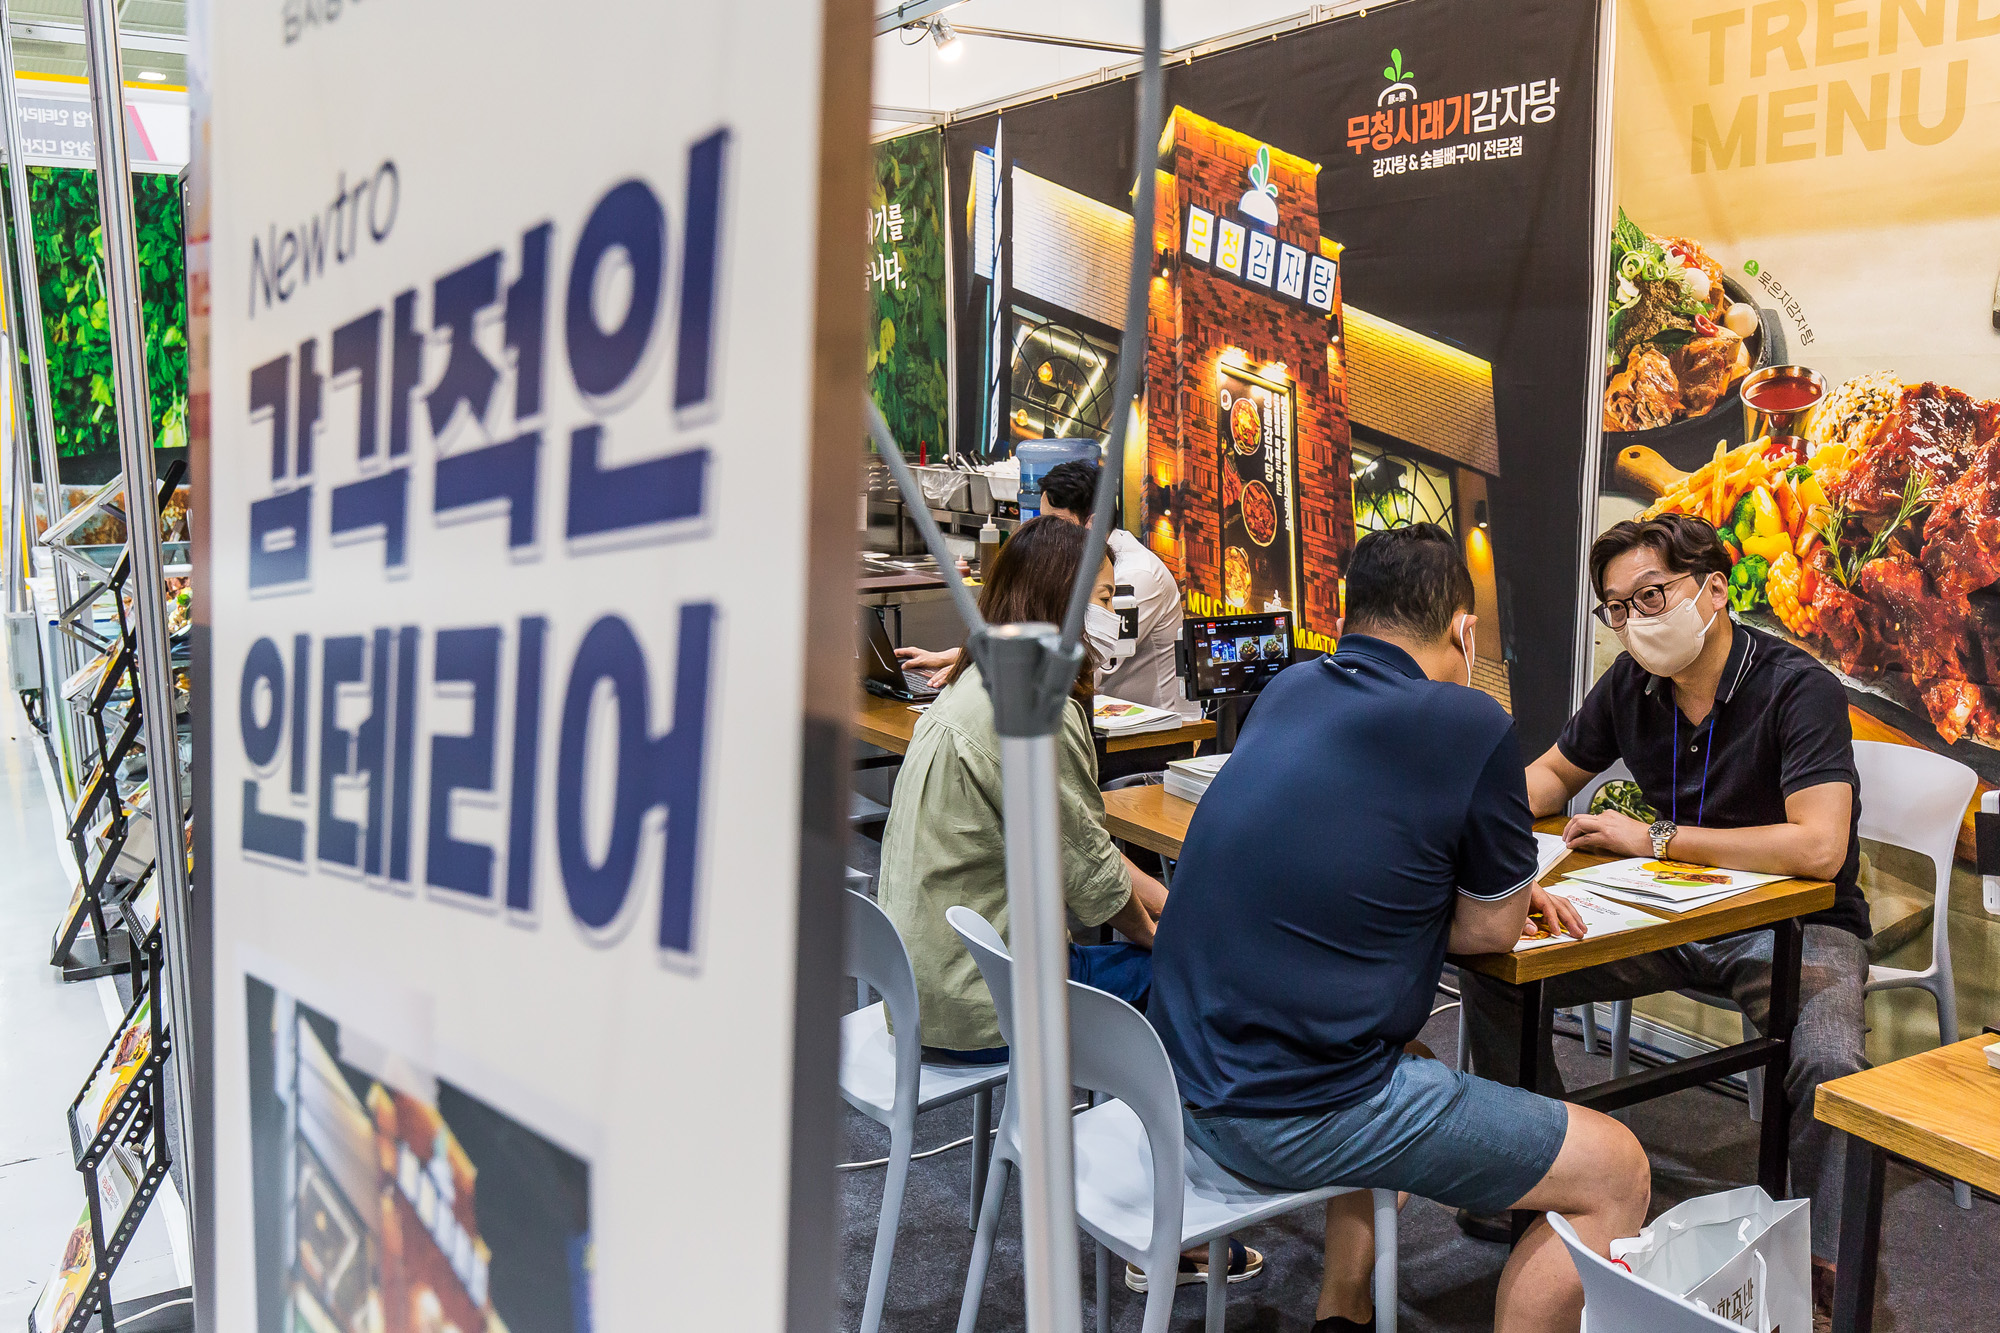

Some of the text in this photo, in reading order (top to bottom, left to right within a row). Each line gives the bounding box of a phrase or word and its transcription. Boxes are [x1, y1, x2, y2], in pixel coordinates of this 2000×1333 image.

[1347, 77, 1560, 155] 무청시래기감자탕
[1373, 136, 1523, 178] 감자탕 & 숯불뼈구이 전문점
[1691, 59, 1969, 175] MENU
[248, 157, 400, 319] Newtro
[1190, 213, 1332, 304] 무청감자탕
[1757, 270, 1815, 347] 묵은지감자탕
[248, 123, 735, 596] 감각적인
[1188, 589, 1256, 617] MUCH
[239, 600, 722, 975] 인테리어
